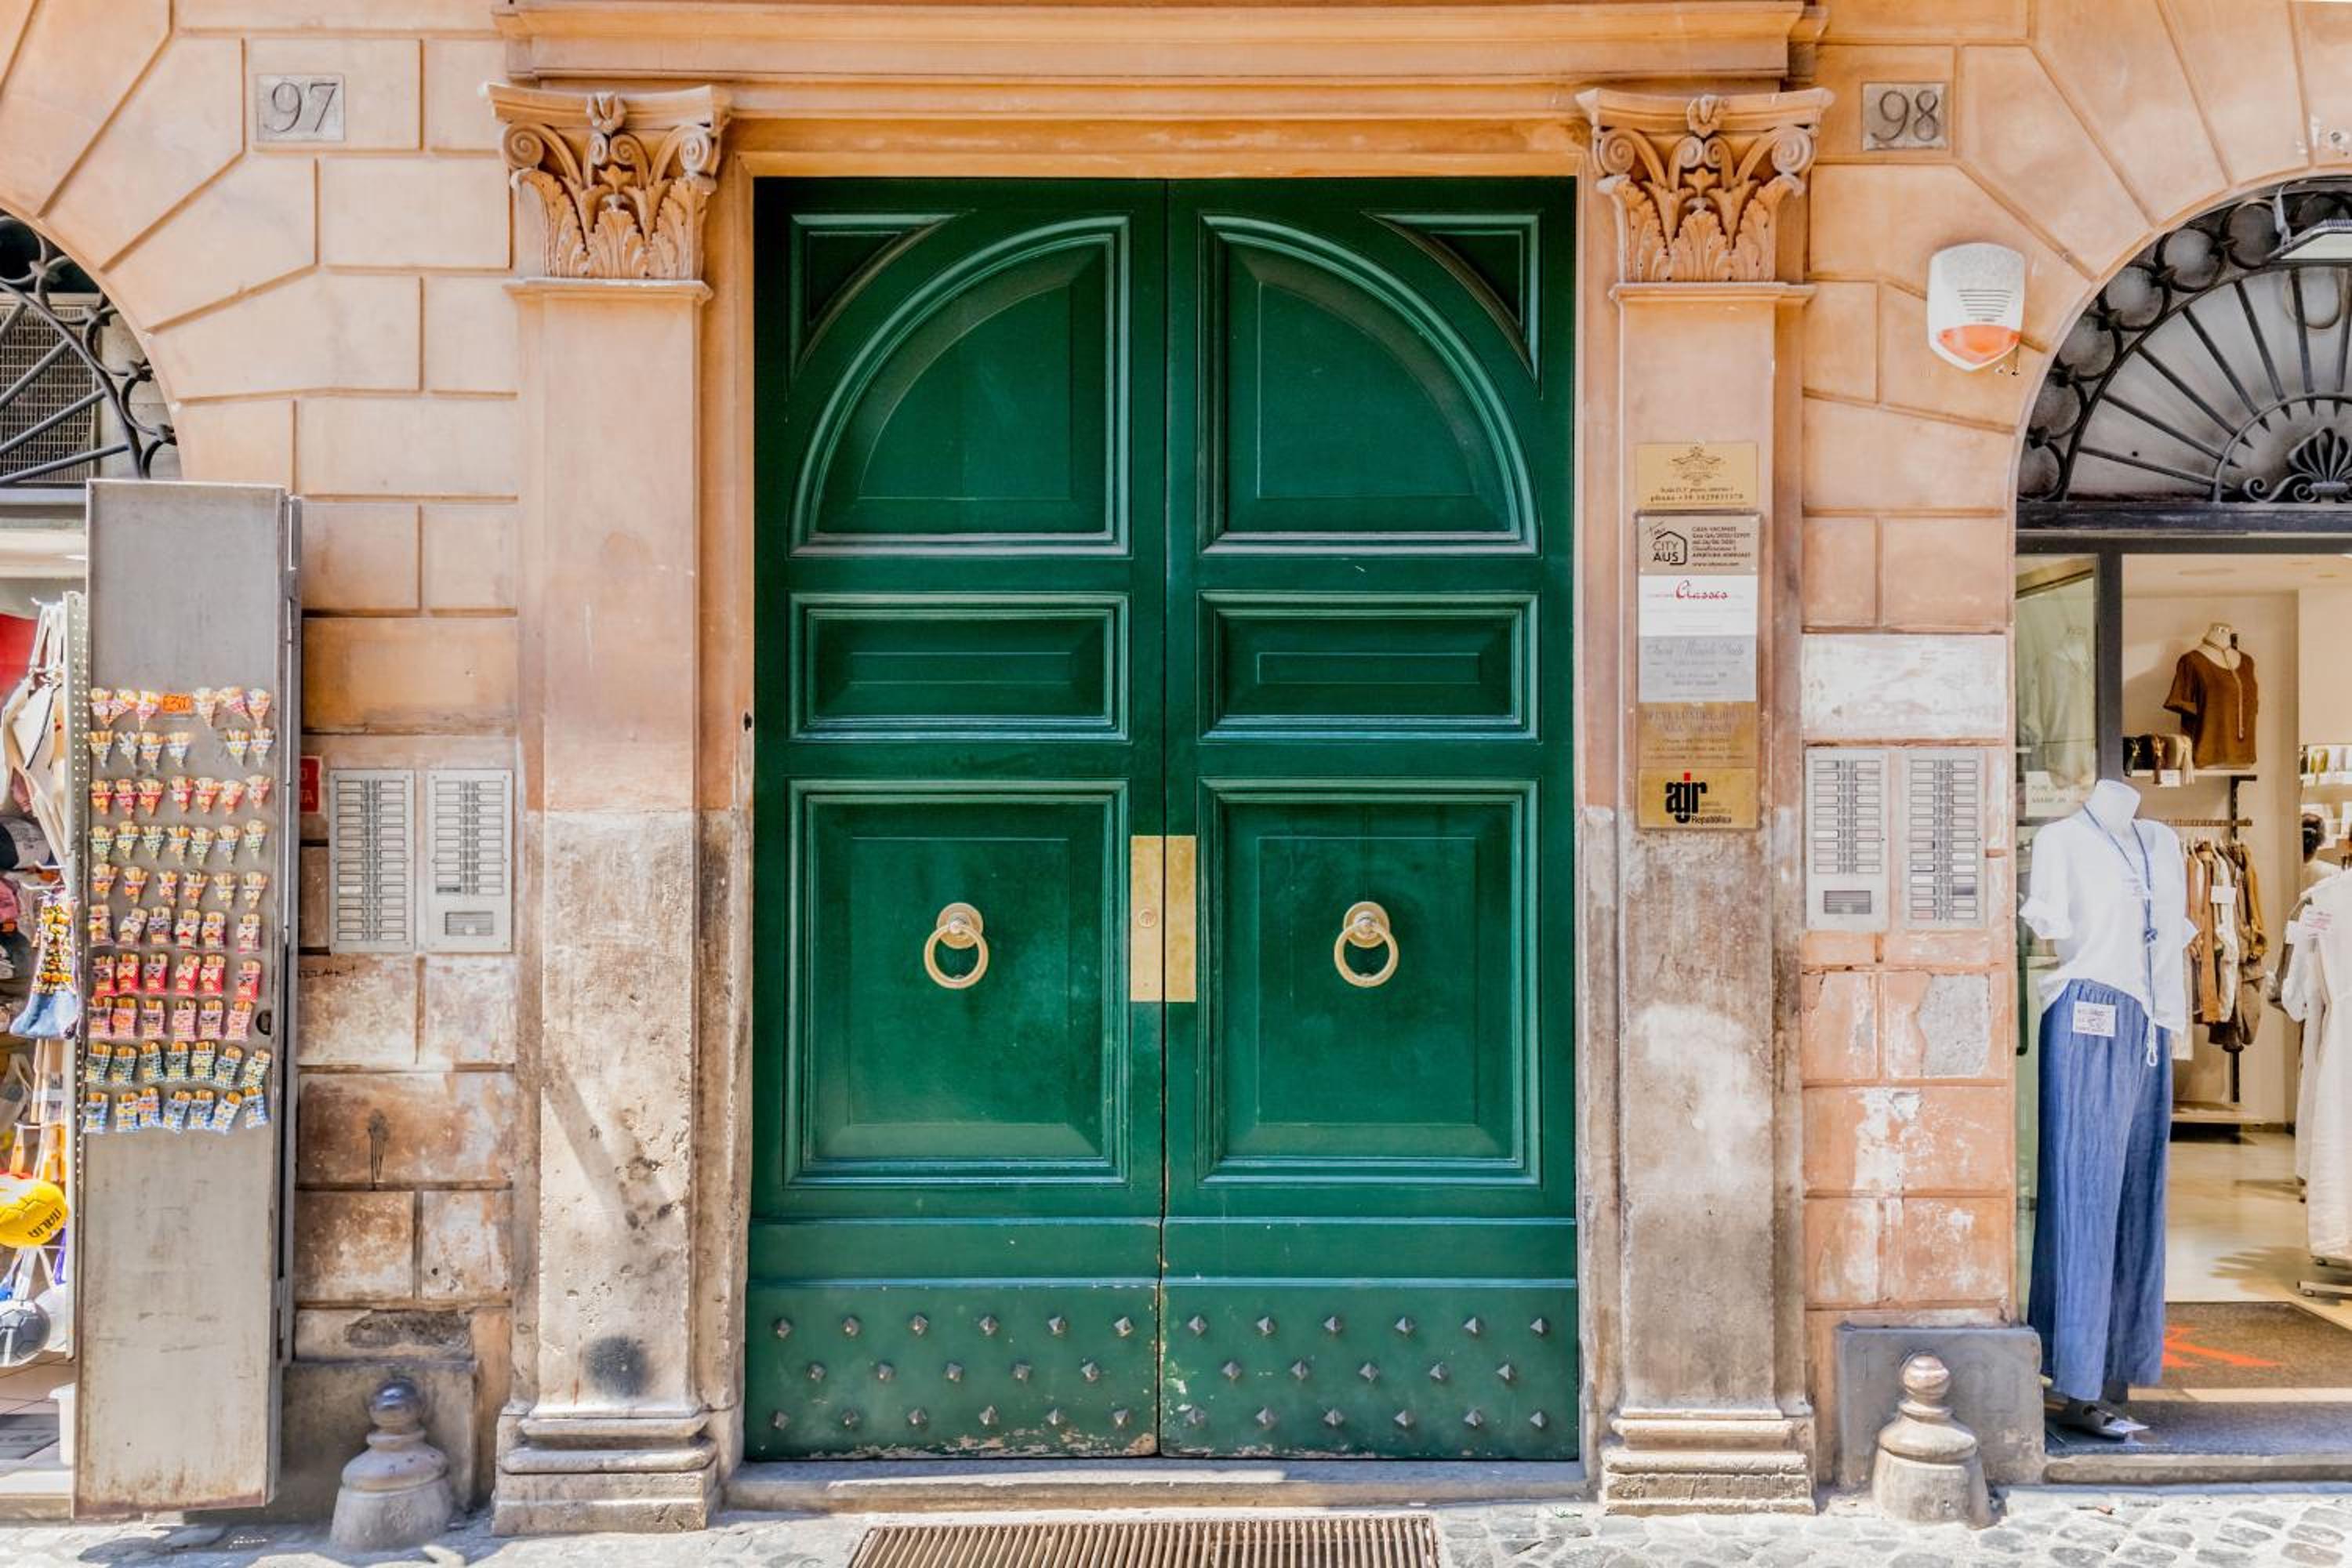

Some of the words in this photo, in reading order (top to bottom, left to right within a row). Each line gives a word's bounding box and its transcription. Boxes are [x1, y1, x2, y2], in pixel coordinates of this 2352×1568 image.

[263, 82, 338, 133] 97
[1871, 89, 1940, 142] 98
[1652, 541, 1678, 551] CITY
[1653, 551, 1679, 562] AUS
